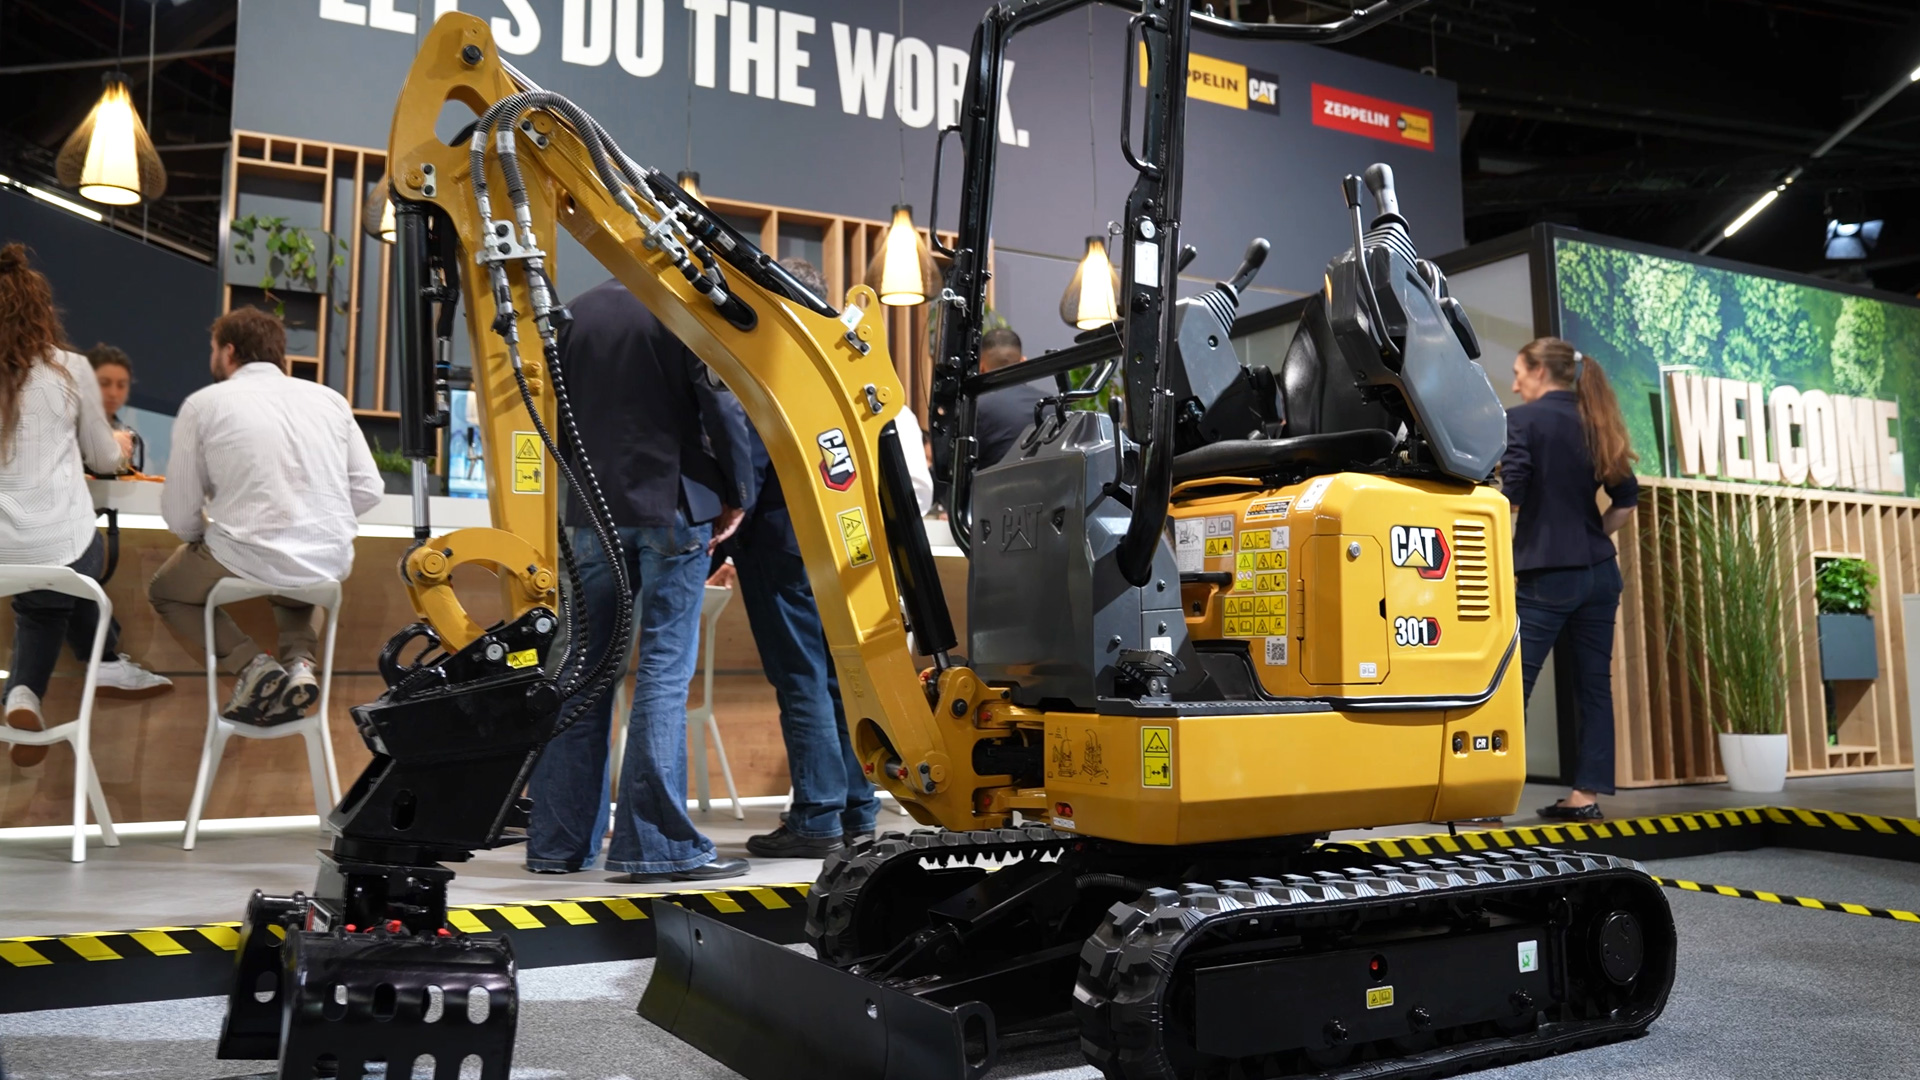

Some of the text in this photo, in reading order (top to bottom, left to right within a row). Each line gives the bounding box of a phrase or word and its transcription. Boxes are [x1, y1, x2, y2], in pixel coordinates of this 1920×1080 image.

[562, 0, 664, 77] DO
[684, 0, 816, 107] THE
[1187, 68, 1278, 105] PELIN CAT
[1324, 99, 1390, 128] ZEPPELIN
[818, 428, 855, 476] CAT
[1669, 372, 1906, 492] WELCOME
[1002, 503, 1043, 551] CAT
[1391, 526, 1437, 567] CAT
[1395, 618, 1430, 645] 301
[1476, 738, 1487, 749] CR
